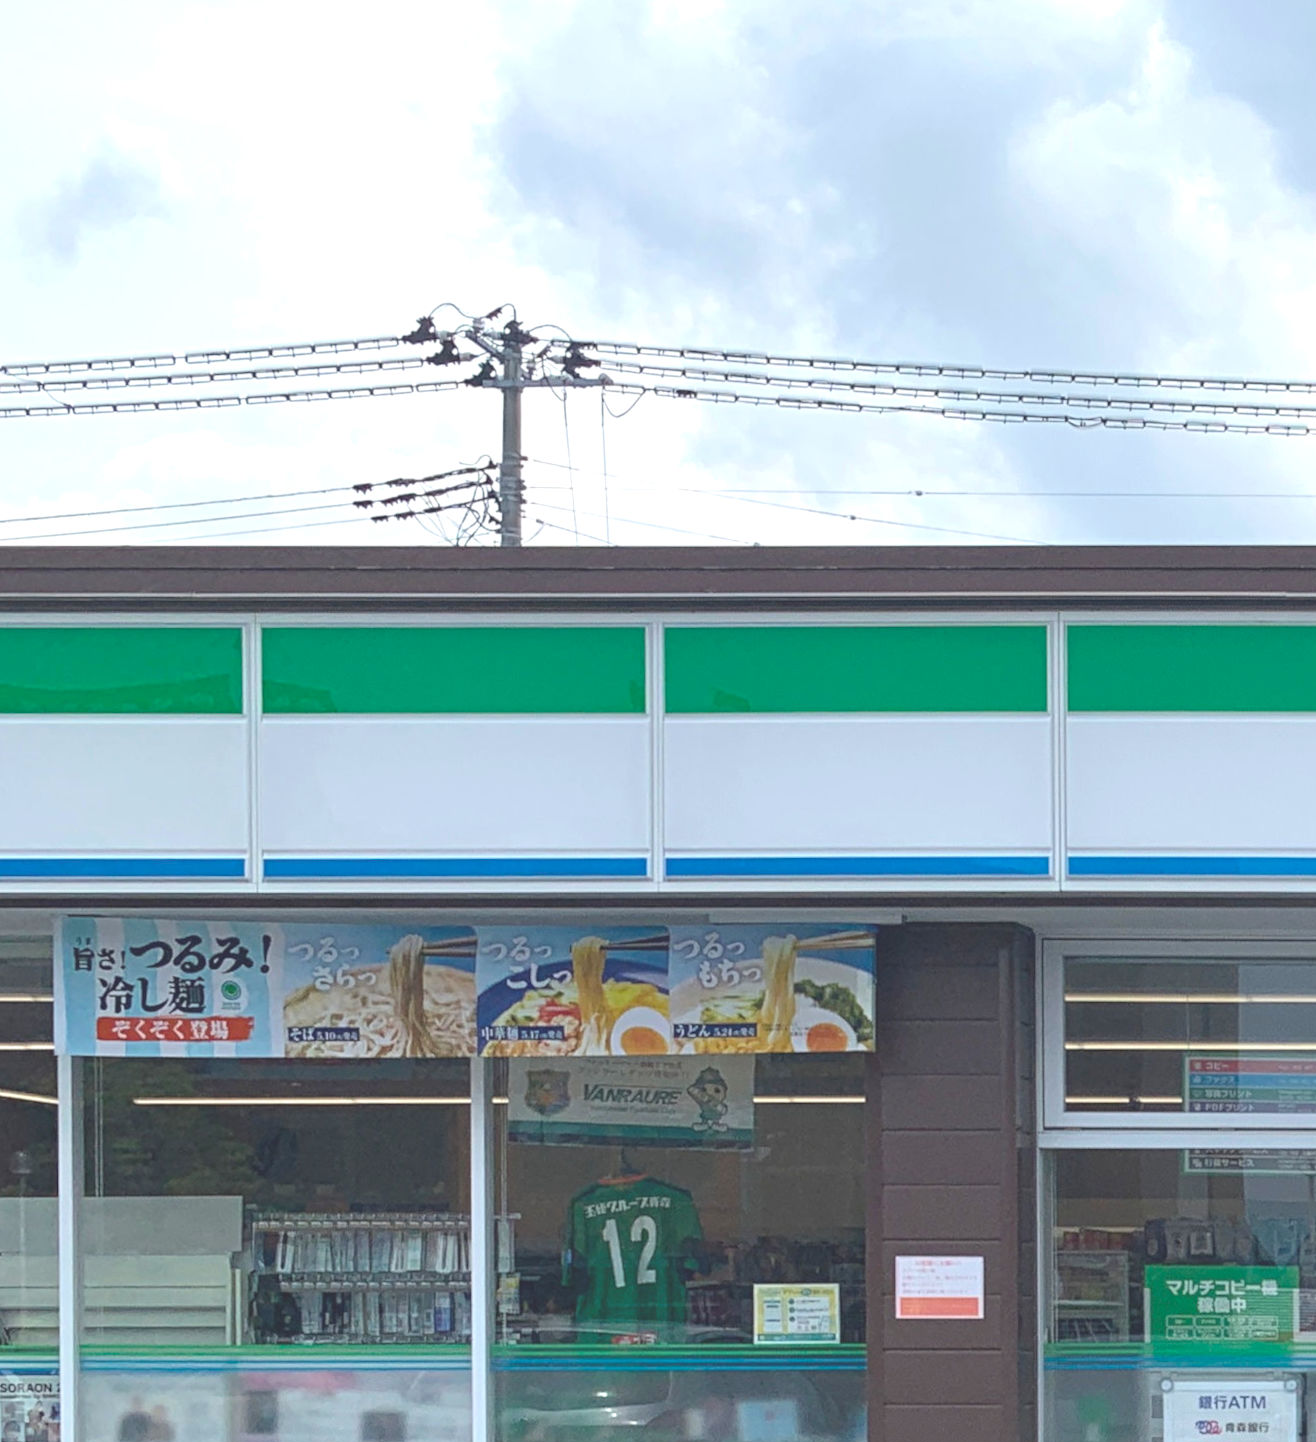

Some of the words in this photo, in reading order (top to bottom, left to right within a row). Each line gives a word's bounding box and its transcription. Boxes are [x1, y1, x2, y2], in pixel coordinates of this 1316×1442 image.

[129, 935, 272, 973] つるみ!
[288, 937, 360, 962] つるっ
[482, 936, 552, 961] つるっ
[673, 932, 745, 959] つるっ
[313, 964, 377, 990] さらっ
[506, 963, 572, 989] こしっ
[699, 959, 761, 988] もちっ
[99, 976, 206, 1014] 冷し麺
[112, 1020, 229, 1039] ぞくぞく登場
[290, 1027, 315, 1041] そば
[676, 1024, 710, 1037] うどん
[584, 1084, 682, 1104] VANRAURE
[603, 1215, 656, 1288] 12
[1166, 1279, 1278, 1296] マルチコピー機
[1199, 1395, 1266, 1410] 銀行ATM
